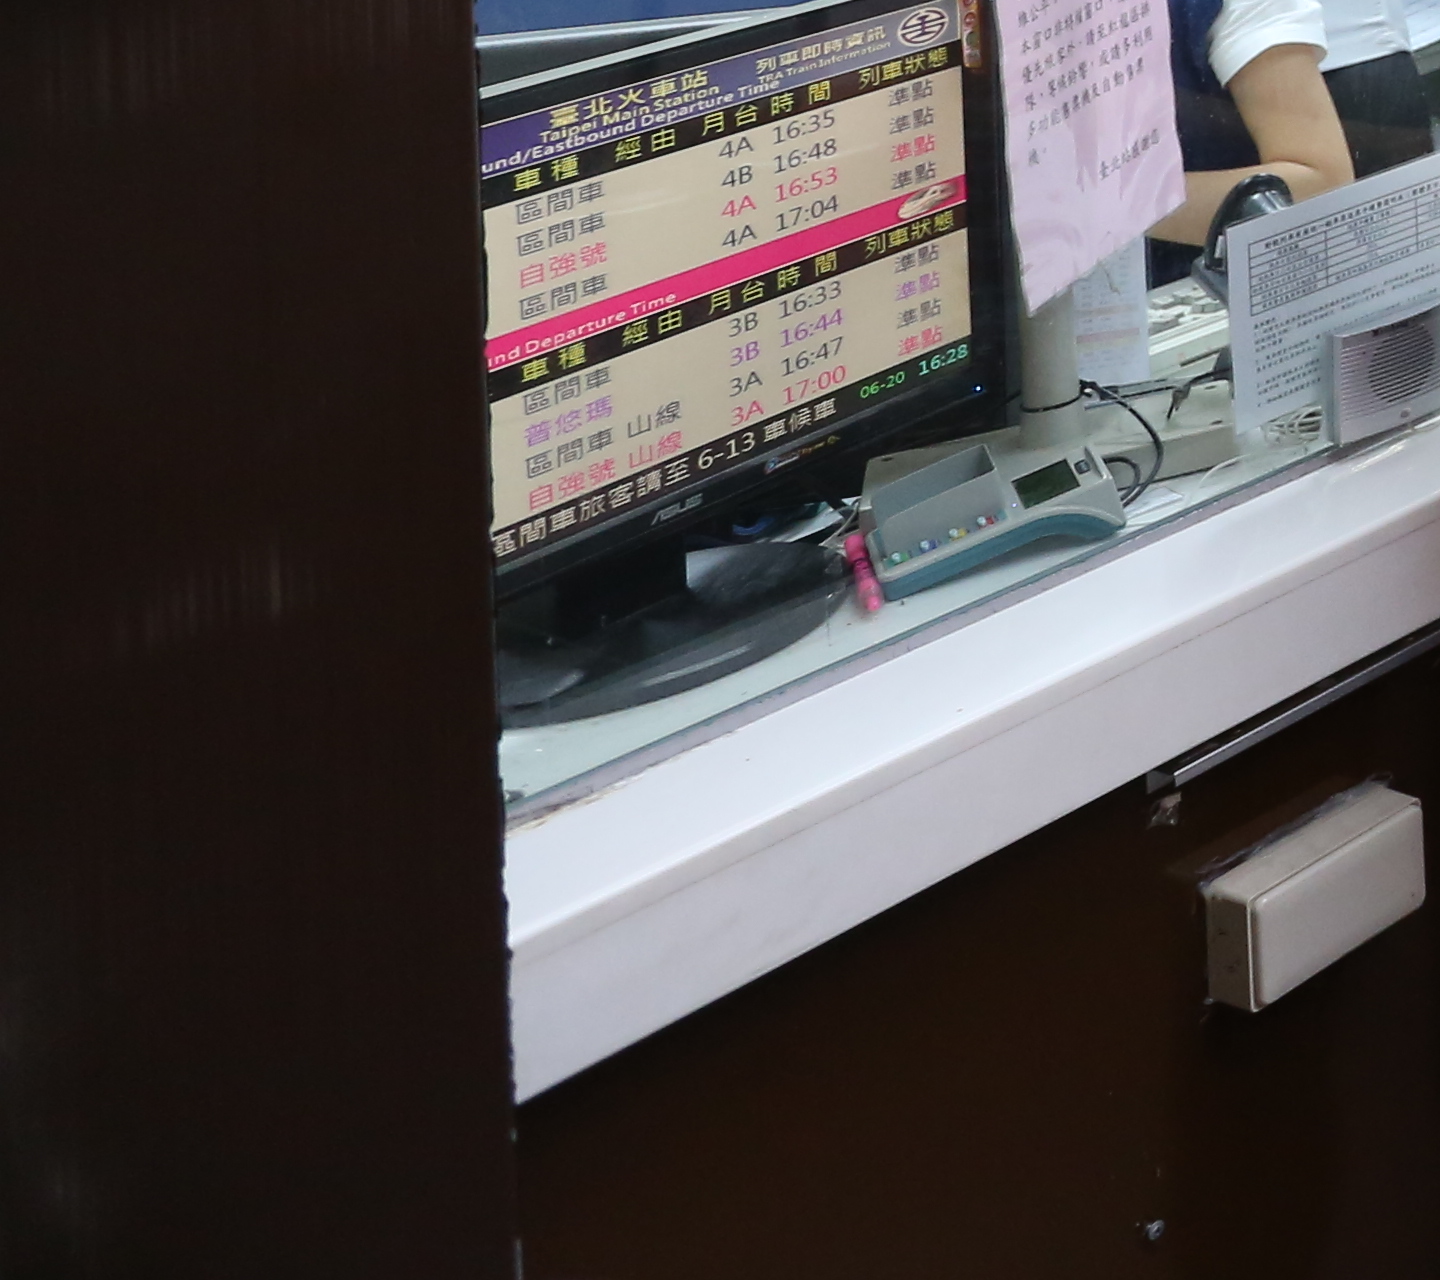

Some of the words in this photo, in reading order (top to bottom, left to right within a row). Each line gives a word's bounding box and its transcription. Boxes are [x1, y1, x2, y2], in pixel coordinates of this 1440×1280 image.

[540, 119, 598, 144] Taipei
[602, 103, 651, 127] Main
[653, 84, 720, 111] Station
[549, 68, 709, 129] 臺北火車站
[640, 90, 735, 129] Departure
[737, 78, 781, 100] Time
[759, 69, 784, 84] TRA
[787, 58, 819, 78] Train
[819, 41, 892, 69] Information
[514, 154, 581, 193] 車種
[614, 128, 677, 164] 經由
[701, 104, 759, 137] 月台
[770, 80, 832, 117] 時間
[515, 180, 605, 226] 區間車
[718, 136, 755, 160] 4A
[772, 108, 836, 145] 16:35
[517, 211, 607, 257] 區間車
[720, 165, 755, 188] 4B
[773, 138, 838, 175] 16:48
[520, 241, 608, 290] 自強號
[720, 195, 758, 218] 4A
[774, 167, 839, 203] 16:53
[518, 272, 609, 322] 區間車
[721, 224, 758, 249] 4A
[775, 194, 840, 234] 17:04
[520, 342, 588, 384] 車種
[621, 309, 683, 348] 經由
[707, 279, 765, 317] 月台
[776, 252, 838, 291] 時間
[521, 366, 613, 417] 區間車
[728, 311, 760, 338] 3B
[778, 280, 843, 320] 16:33
[524, 308, 627, 354] Departure
[629, 291, 678, 316] Time
[729, 340, 761, 367] 3B
[779, 308, 844, 349] 16:44
[524, 427, 614, 480] 區間車
[627, 400, 682, 439] 山線
[728, 370, 764, 398] 3A
[780, 336, 844, 378] 16:47
[528, 458, 617, 512] 自強號
[628, 430, 683, 470] 山線
[730, 400, 765, 428] 3A
[782, 364, 848, 407] 17:00
[696, 431, 756, 471] 6-13
[859, 370, 907, 400] 06-20
[917, 342, 969, 377] 16:28
